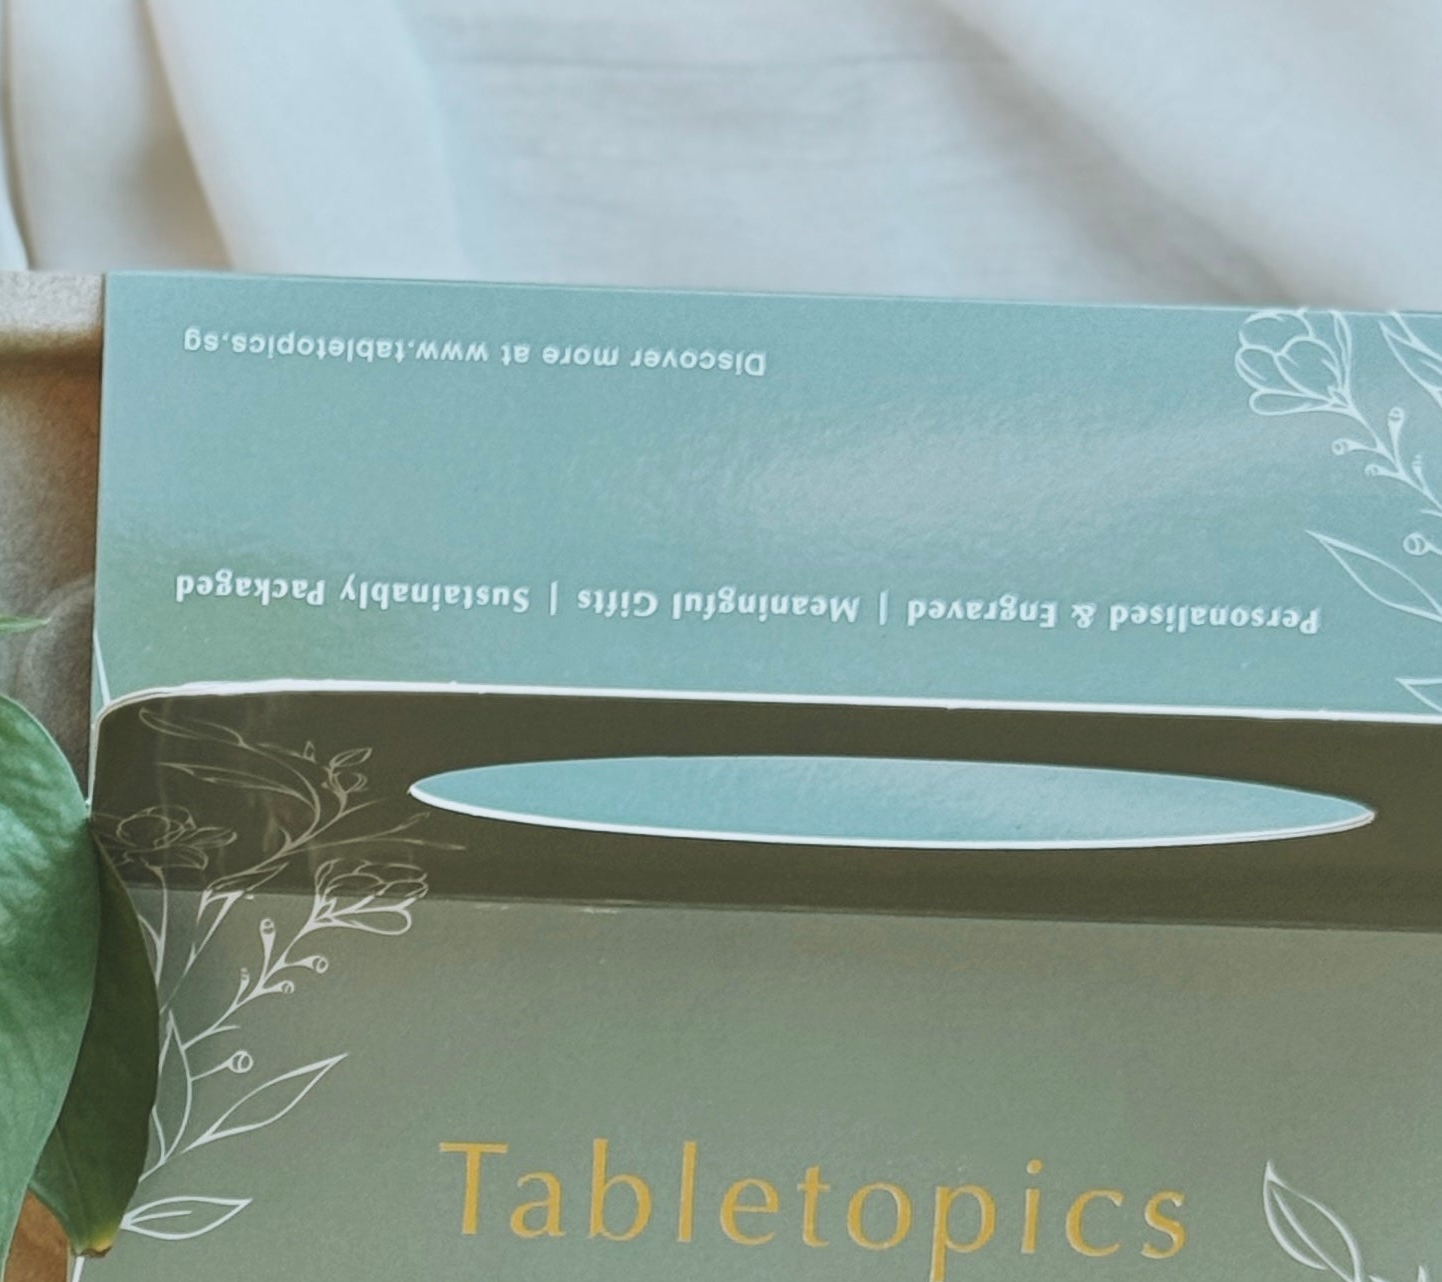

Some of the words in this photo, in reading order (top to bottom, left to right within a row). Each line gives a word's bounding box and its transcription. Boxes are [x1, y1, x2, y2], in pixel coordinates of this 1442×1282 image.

[183, 327, 489, 364] www.tabletopics.sg
[501, 342, 531, 366] at
[542, 345, 620, 368] more
[630, 347, 767, 377] Discover
[175, 568, 326, 606] Packaged
[339, 572, 531, 614] Sustainably
[577, 584, 659, 618] Gifts
[672, 586, 858, 623] Meaningful
[907, 592, 1056, 629] Engraved
[1071, 603, 1098, 629] &
[1109, 602, 1320, 635] Personalised
